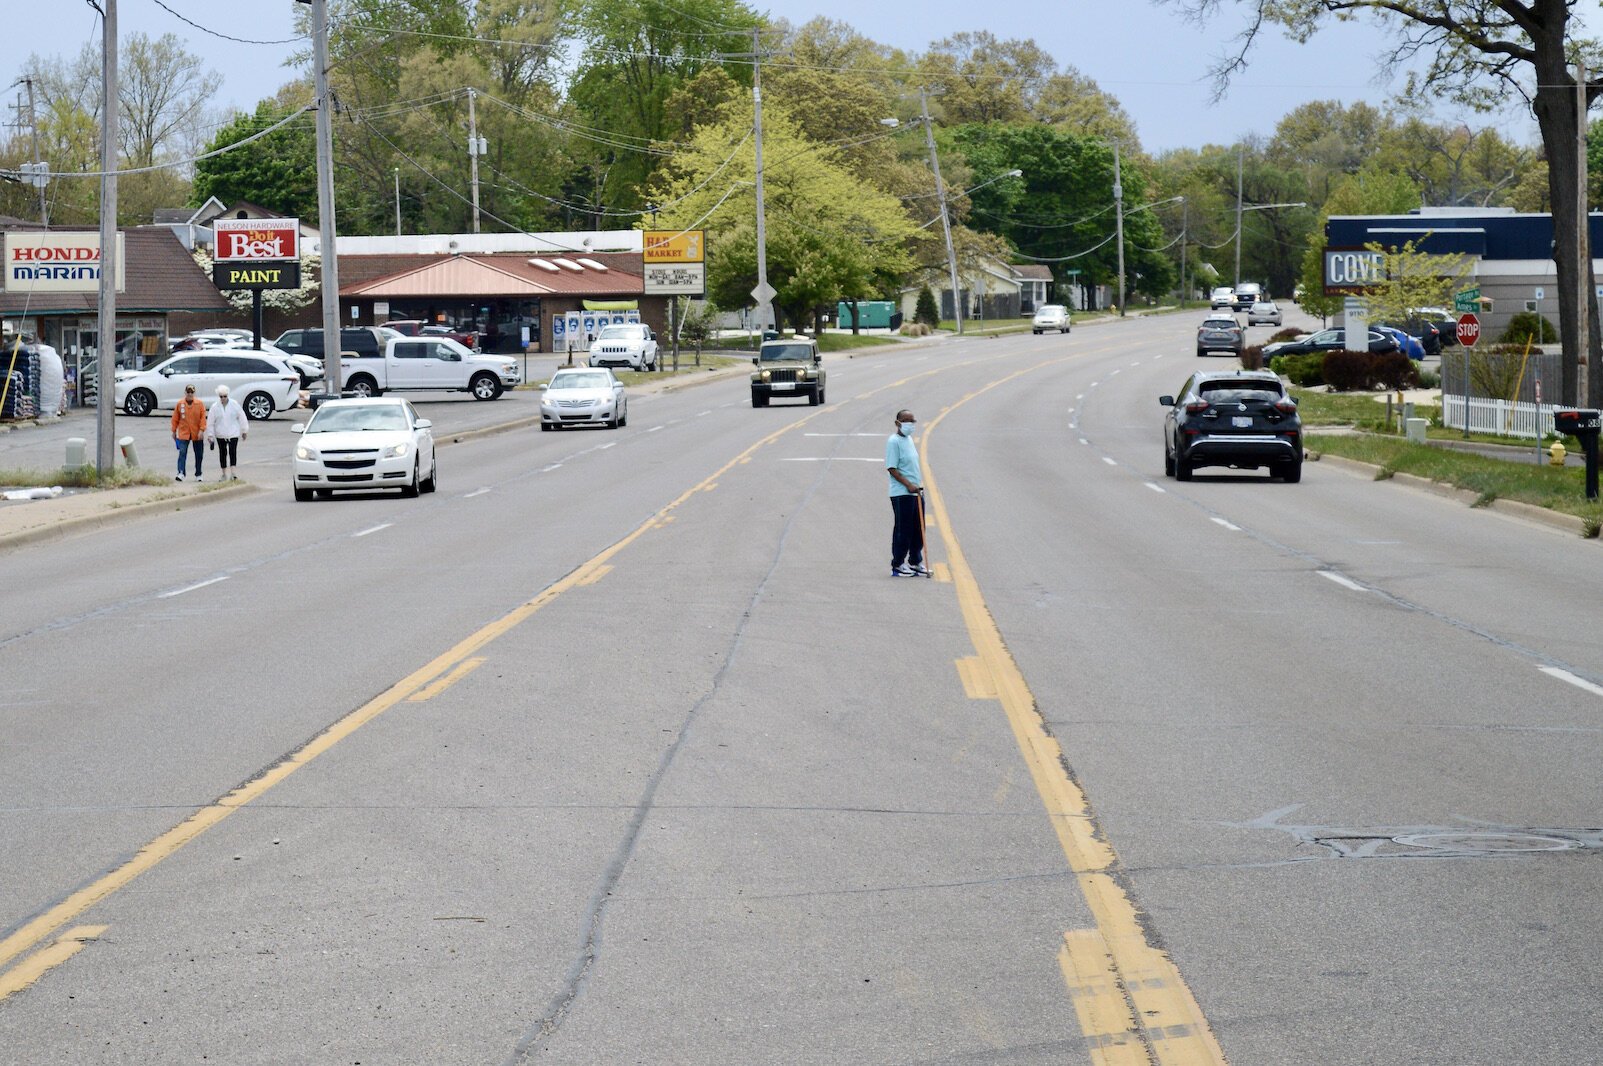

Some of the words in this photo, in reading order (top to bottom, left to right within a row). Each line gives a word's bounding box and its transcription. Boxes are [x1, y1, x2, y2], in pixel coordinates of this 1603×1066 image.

[250, 222, 294, 230] HARDWARE
[228, 233, 285, 258] Best
[646, 250, 682, 258] MARKET
[14, 267, 101, 280] MARIN
[230, 270, 281, 283] PAINT
[1458, 323, 1479, 337] STOP
